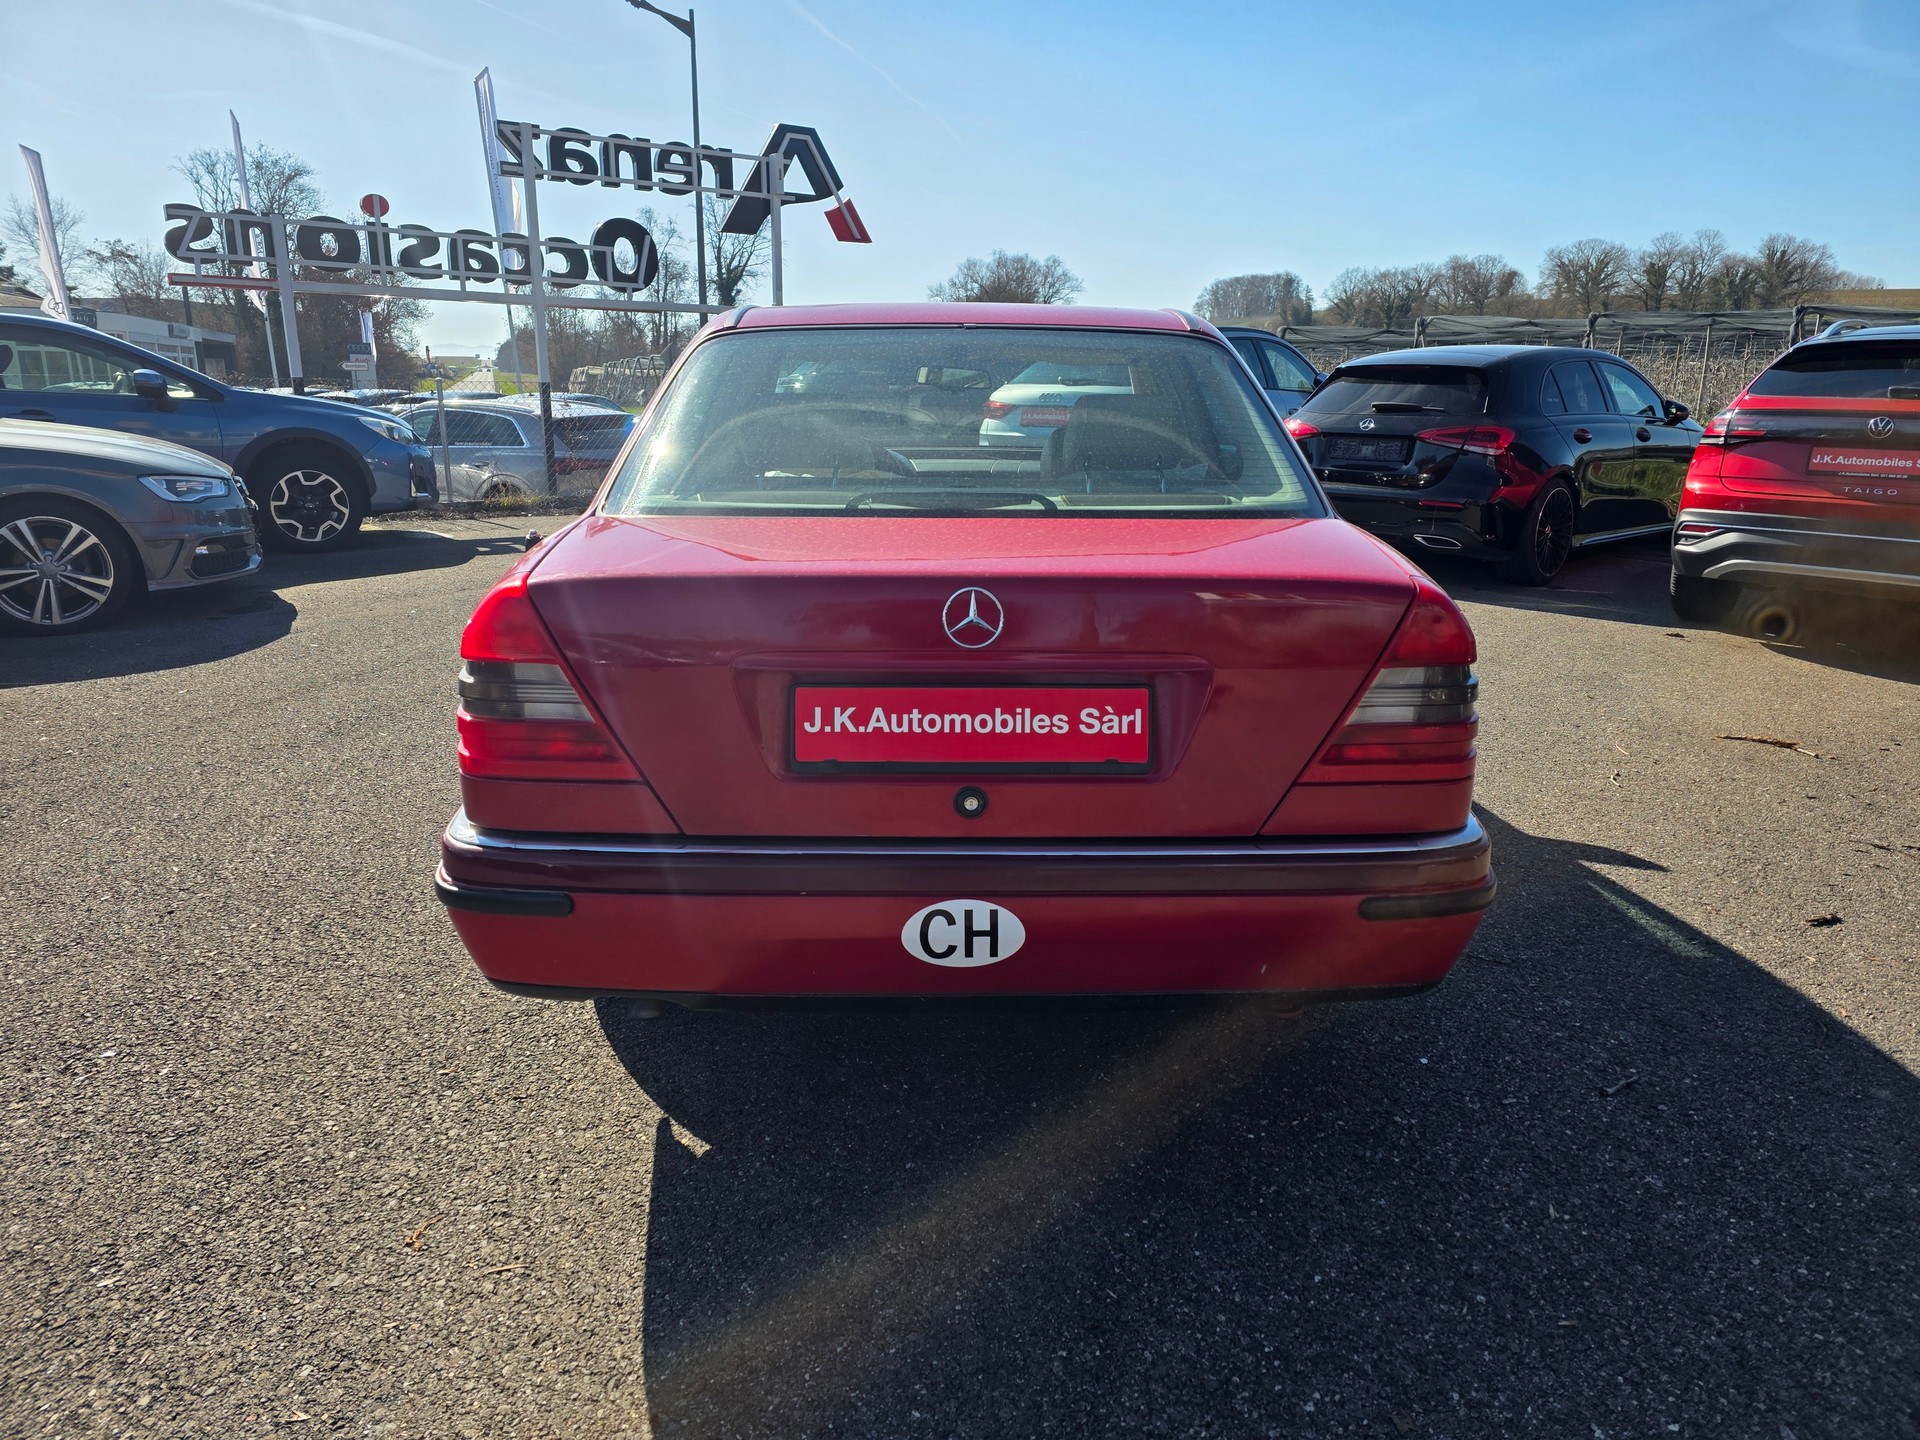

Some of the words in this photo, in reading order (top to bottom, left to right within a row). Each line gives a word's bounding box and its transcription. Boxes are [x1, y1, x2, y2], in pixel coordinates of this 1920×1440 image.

[1812, 455, 1912, 467] J.K.Automobiles
[1843, 486, 1898, 495] TAIGO
[803, 706, 1069, 734] J.K.Automobiles
[1078, 705, 1143, 734] Sàrl
[919, 908, 999, 960] CH
